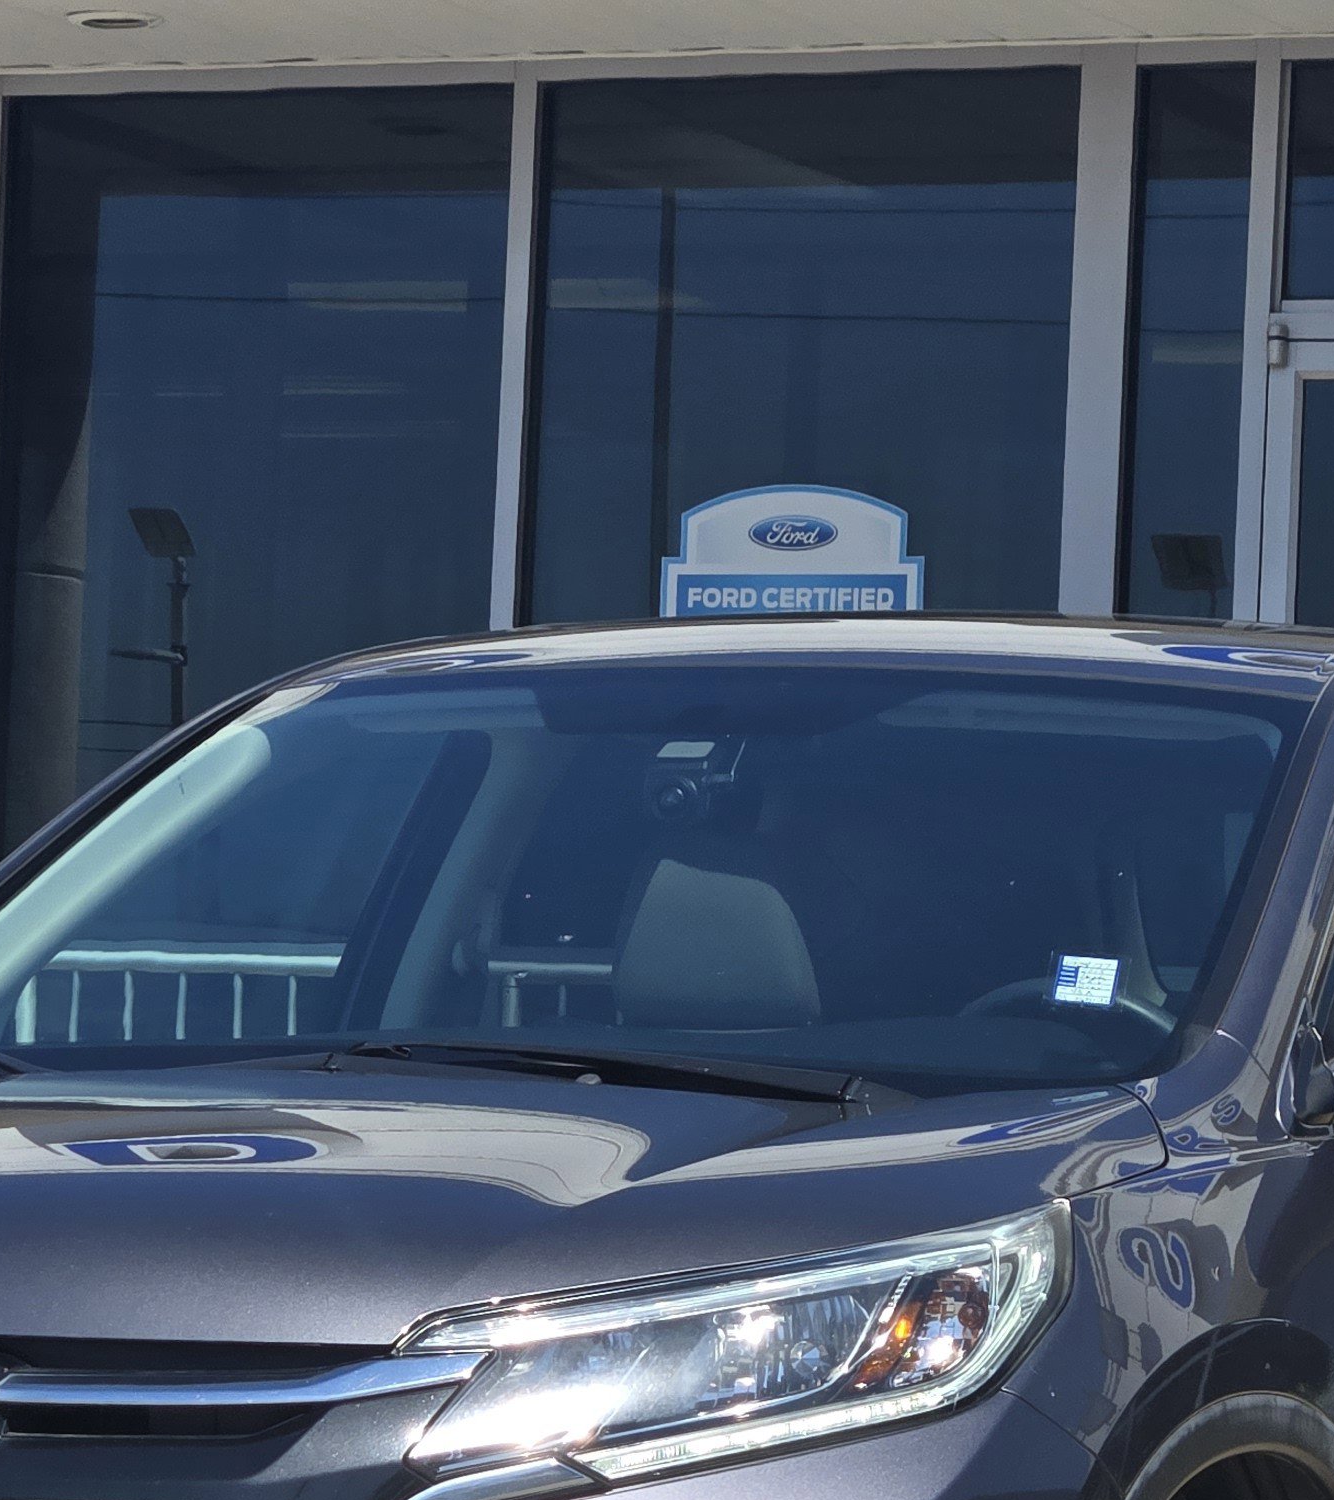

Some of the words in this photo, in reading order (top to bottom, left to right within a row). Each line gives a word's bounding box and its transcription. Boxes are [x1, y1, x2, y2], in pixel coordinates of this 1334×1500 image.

[766, 520, 821, 545] Ford
[686, 587, 757, 609] FORD
[761, 587, 895, 611] CERTIFIED
